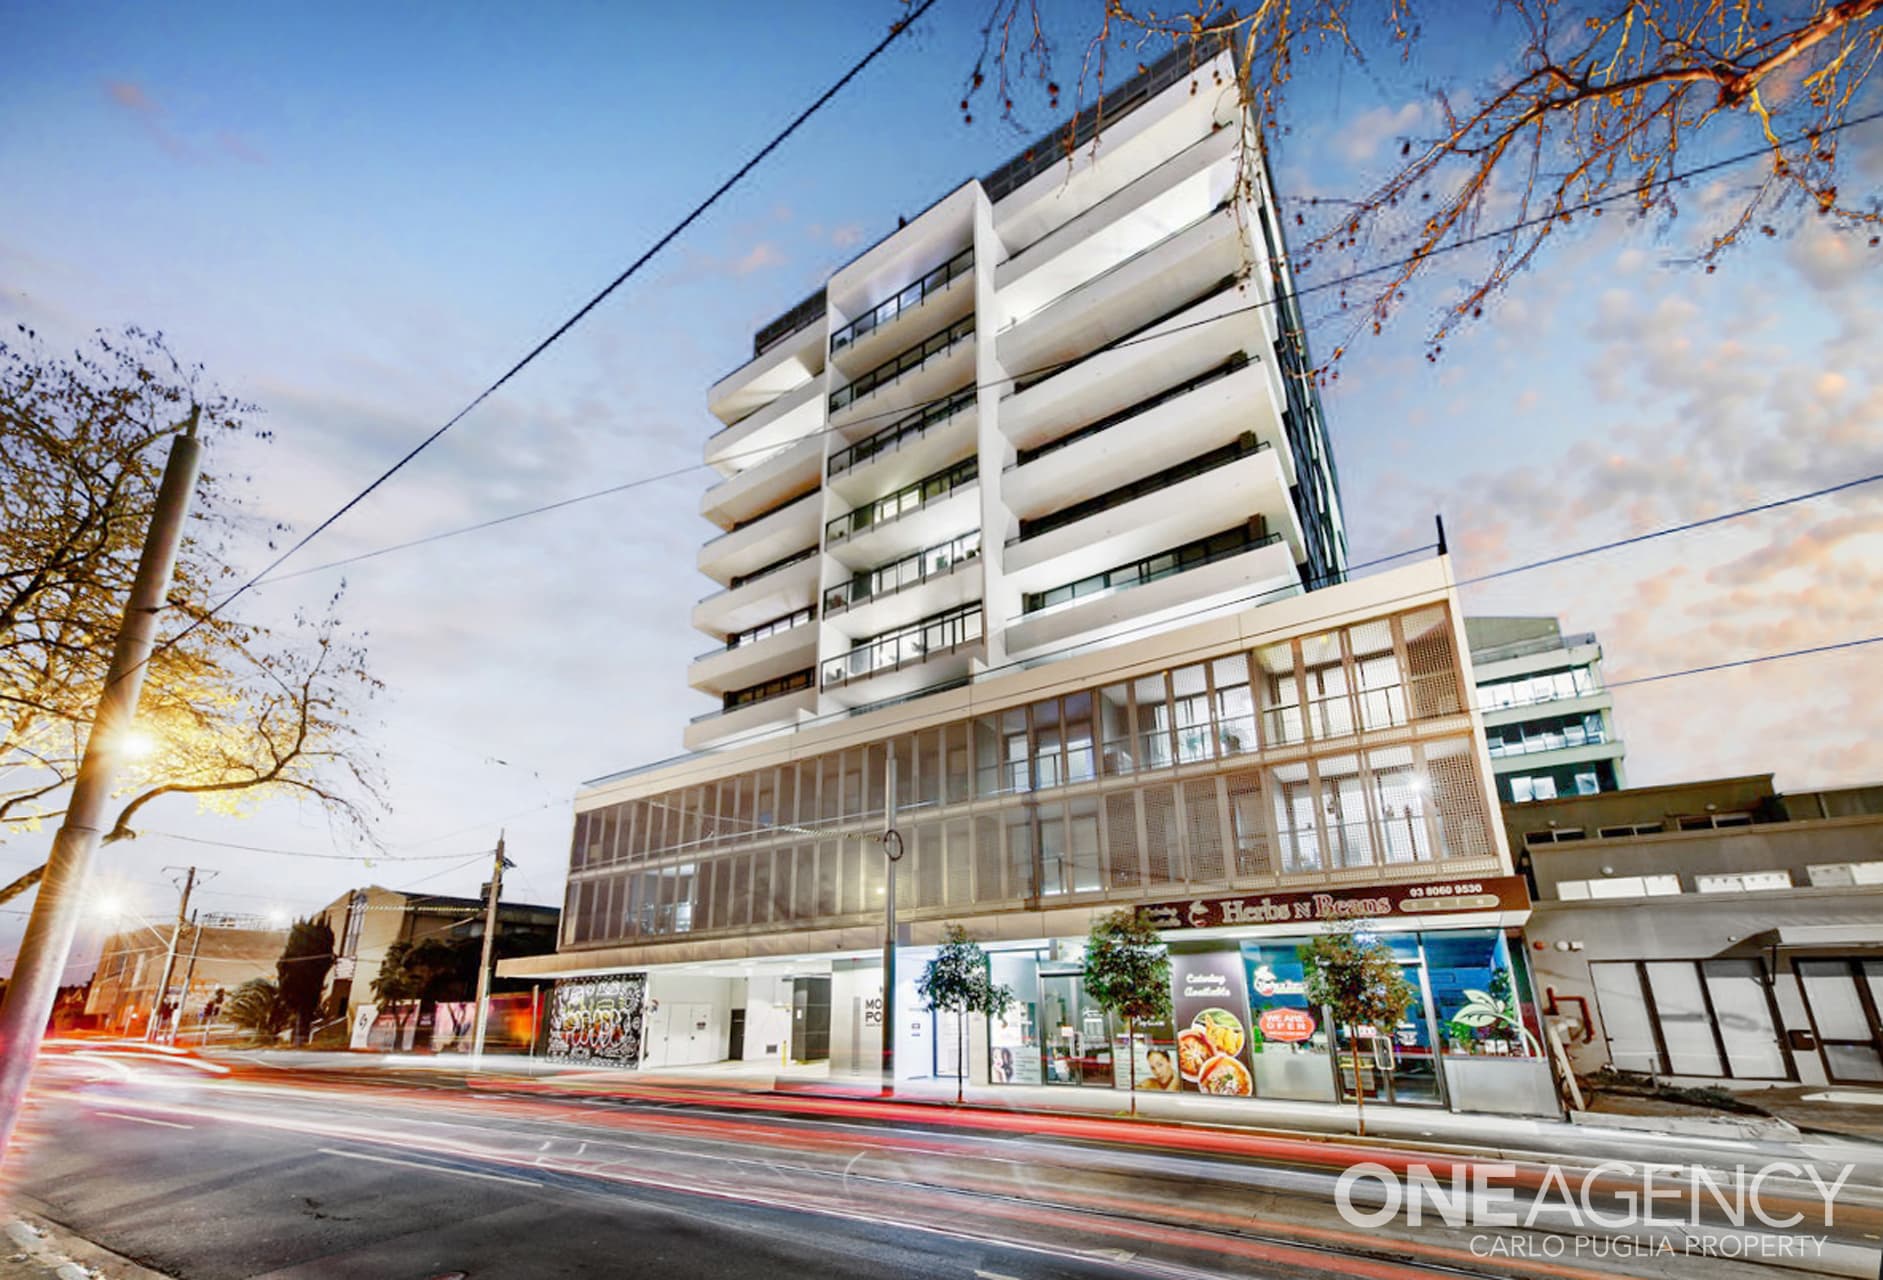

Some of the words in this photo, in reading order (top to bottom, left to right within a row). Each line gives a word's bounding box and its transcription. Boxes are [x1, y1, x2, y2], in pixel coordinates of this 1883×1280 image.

[1220, 898, 1291, 923] Herbs
[1313, 893, 1392, 918] Beans
[1266, 1023, 1307, 1031] OPEN
